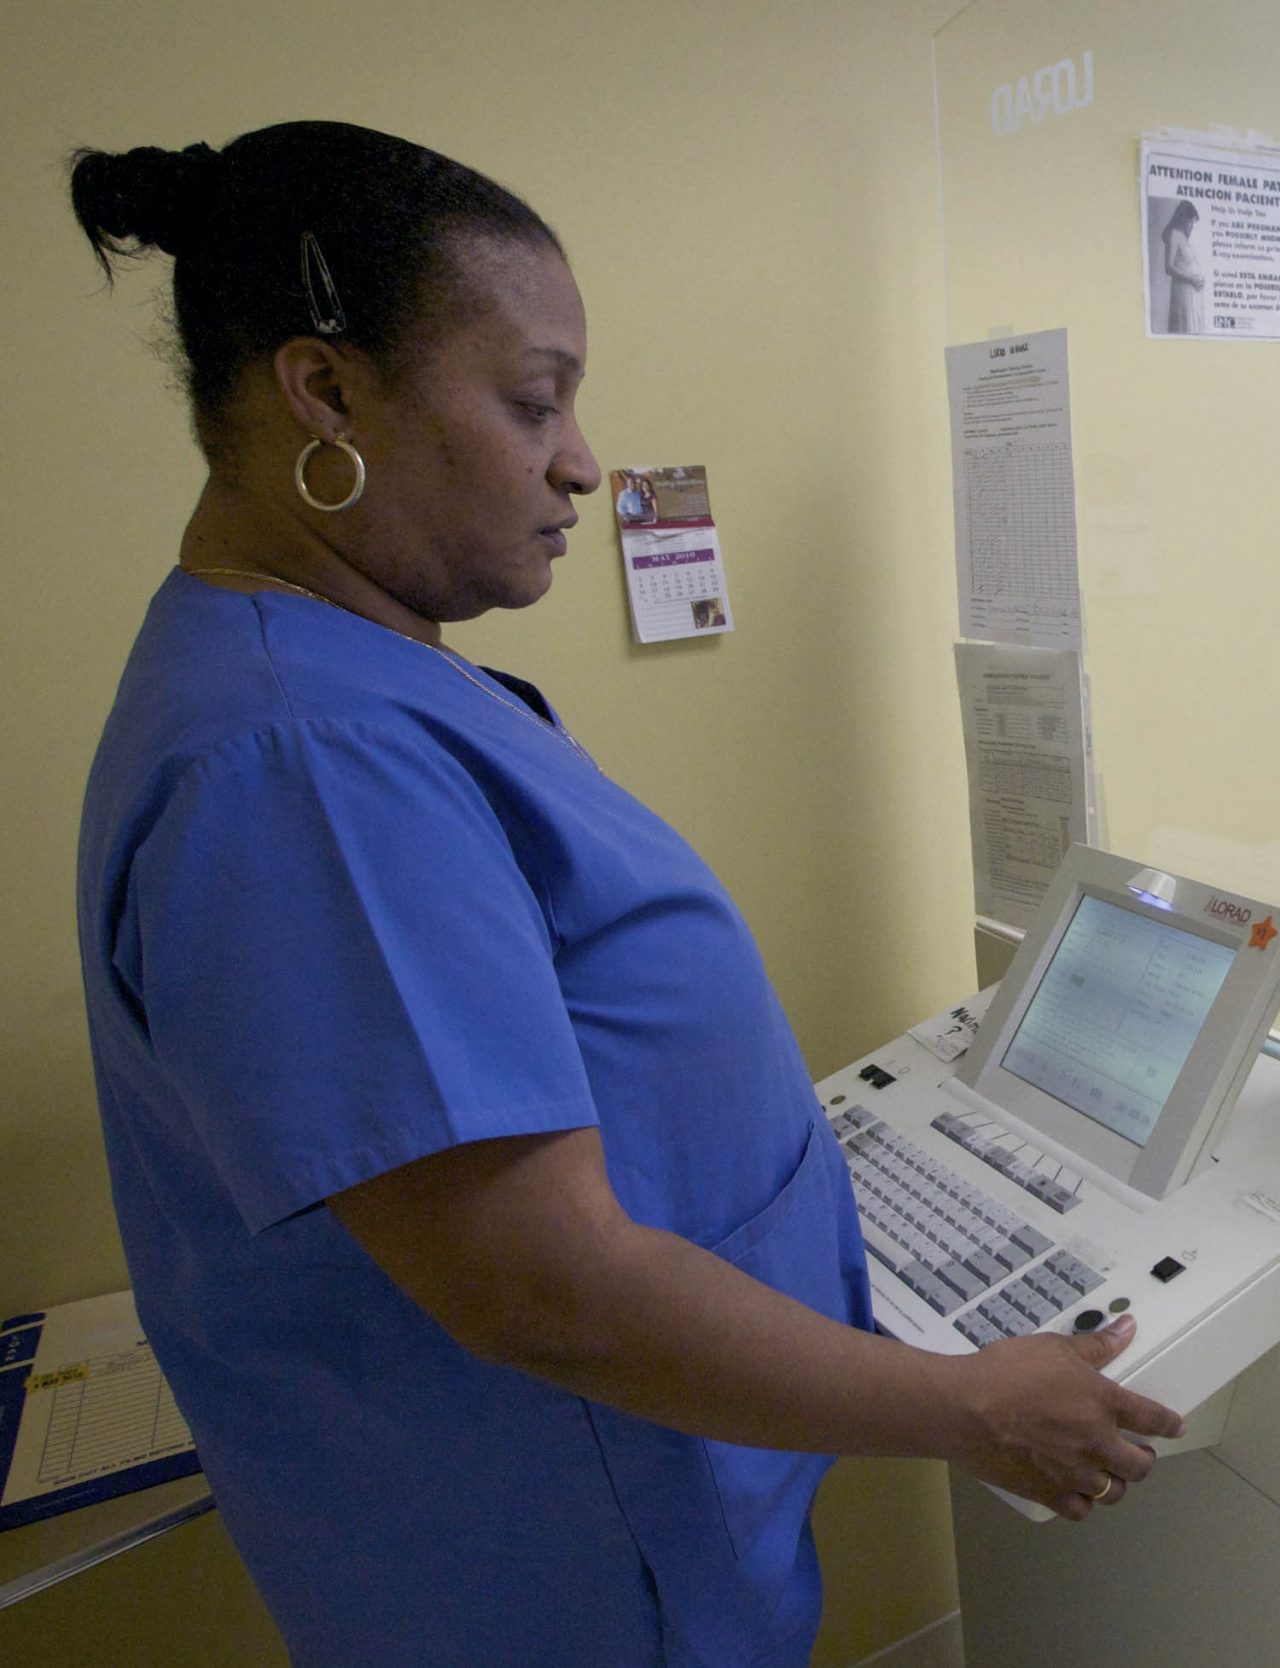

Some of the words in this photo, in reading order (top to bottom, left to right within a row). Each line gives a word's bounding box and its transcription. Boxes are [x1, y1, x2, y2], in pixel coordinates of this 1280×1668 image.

[1149, 164, 1213, 183] ATTENTION
[1217, 173, 1258, 189] FEMALE
[1176, 184, 1232, 200] ATENCION
[651, 553, 670, 562] MAY
[1210, 898, 1252, 923] LORAD
